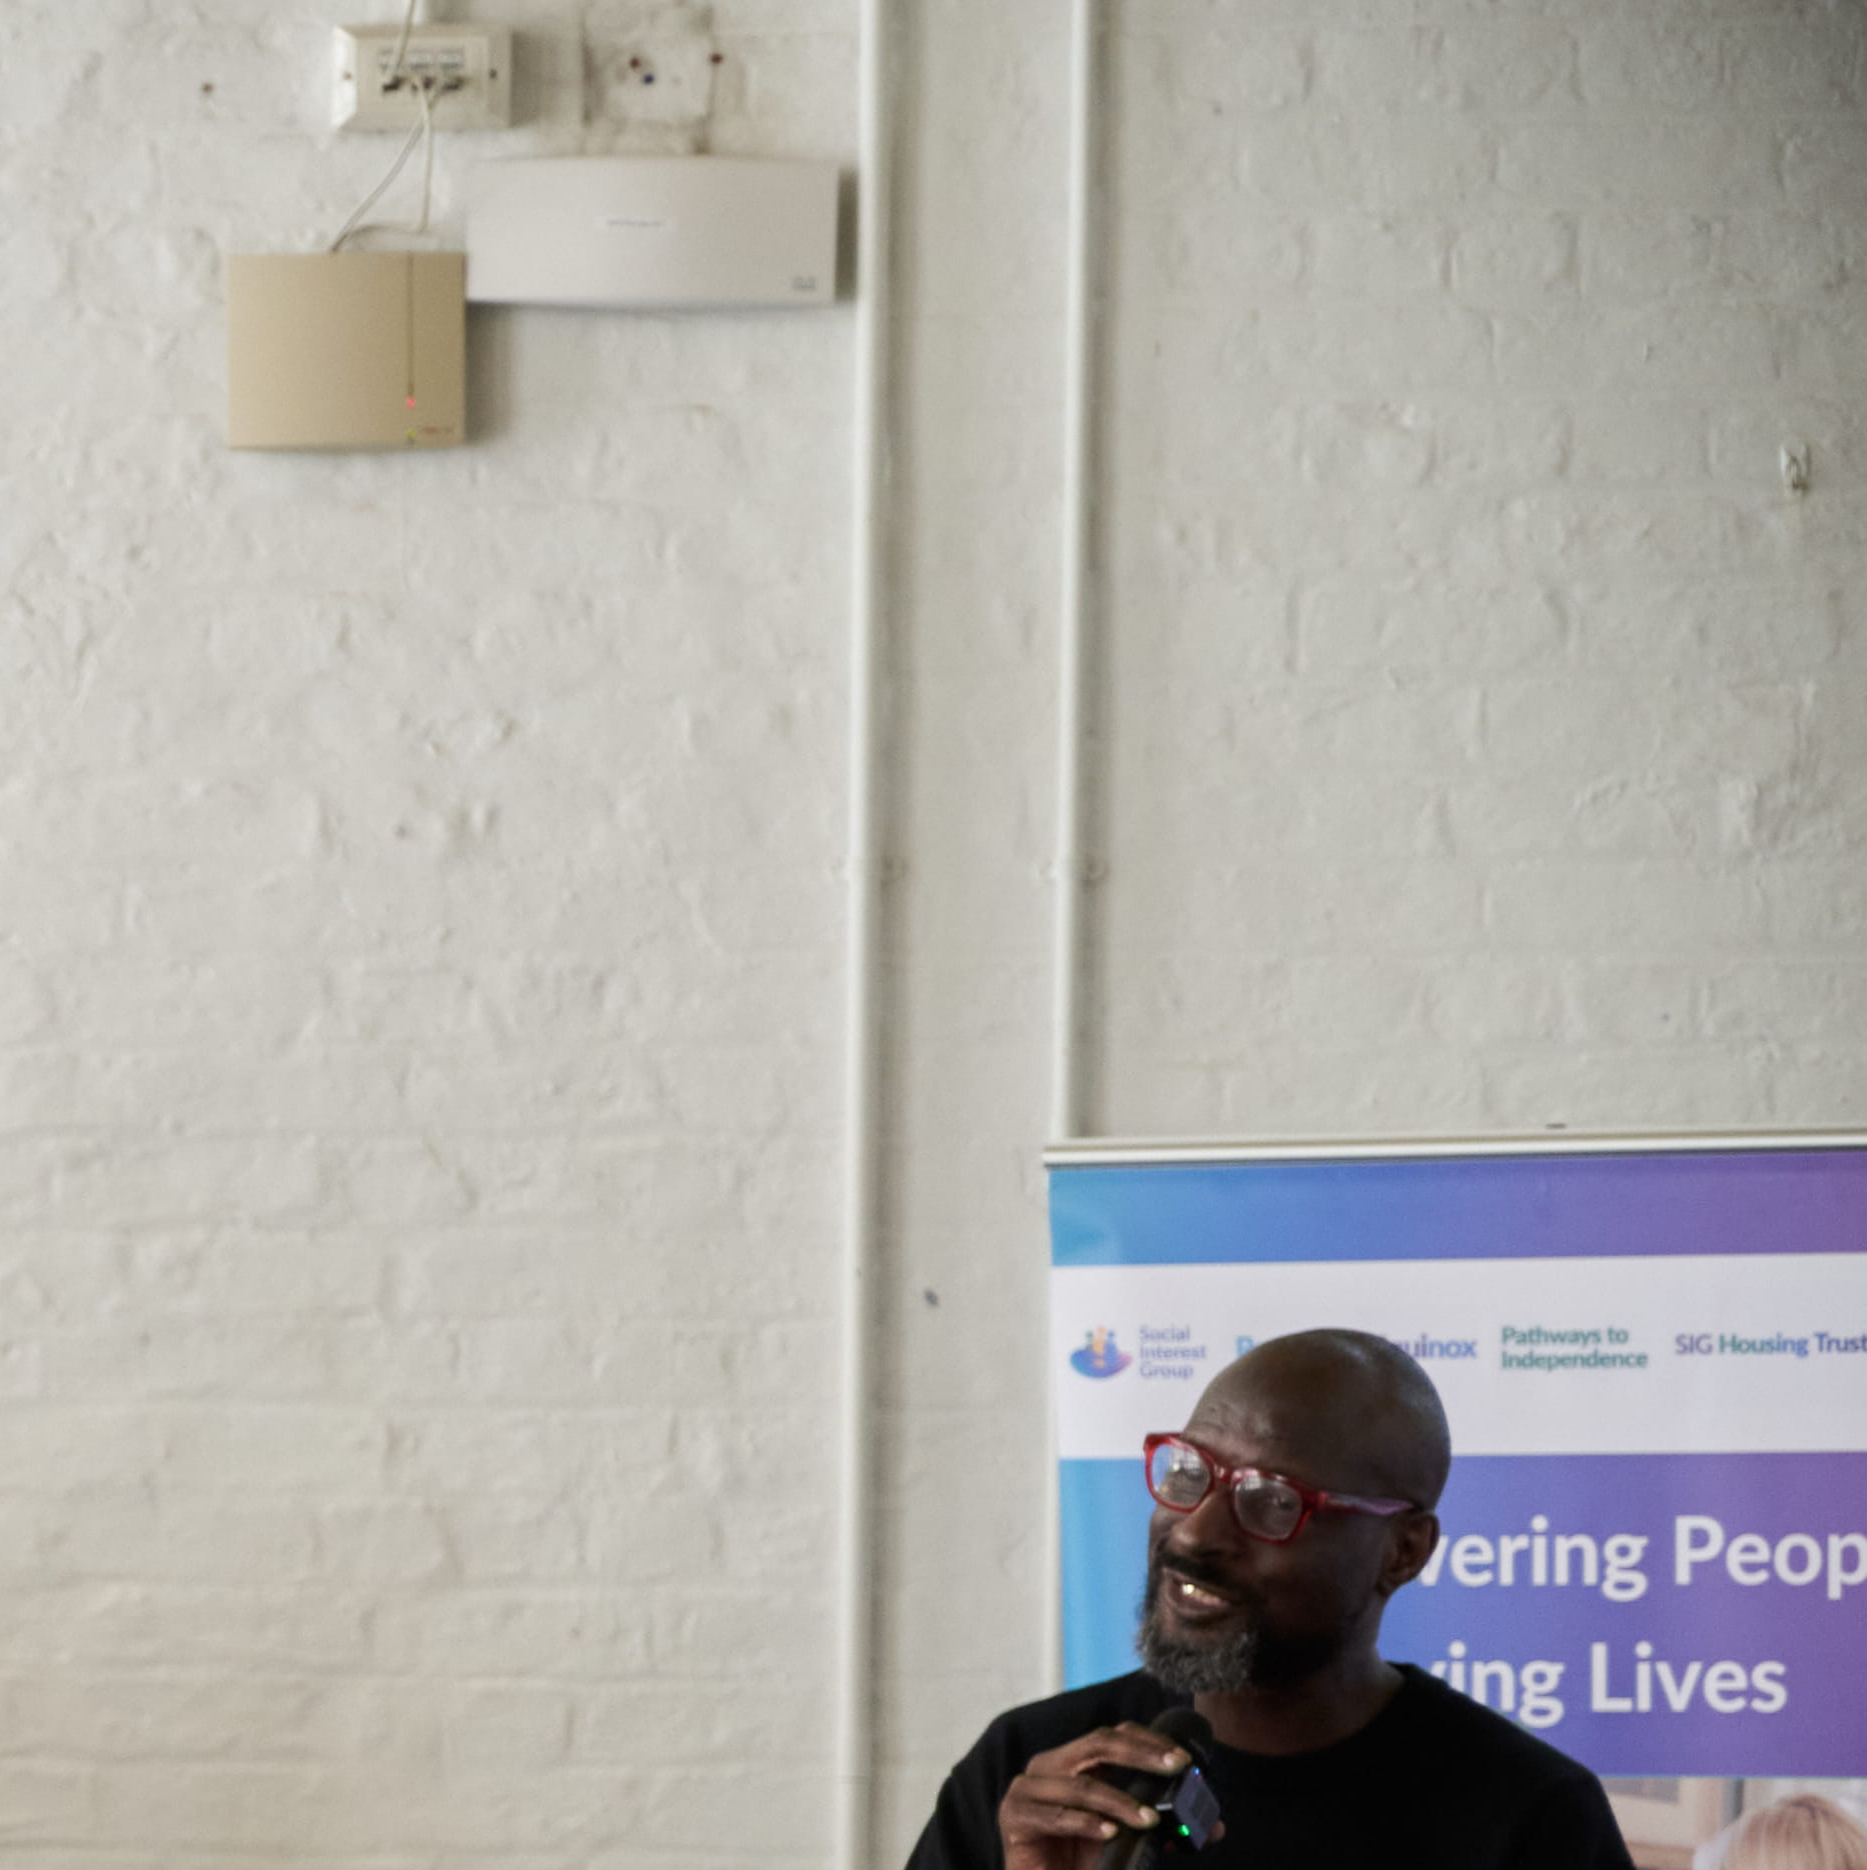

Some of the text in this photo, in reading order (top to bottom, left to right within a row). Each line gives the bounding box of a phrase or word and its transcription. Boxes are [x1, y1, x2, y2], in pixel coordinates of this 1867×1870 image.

[1139, 1324, 1191, 1343] Social
[1500, 1325, 1629, 1350] Pathways to
[1139, 1343, 1207, 1362] Interest
[1674, 1333, 1713, 1355] SIG
[1718, 1332, 1810, 1359] Housing
[1139, 1361, 1195, 1382] Group
[1501, 1349, 1649, 1372] Independence
[1590, 1640, 1788, 1714] Lives
